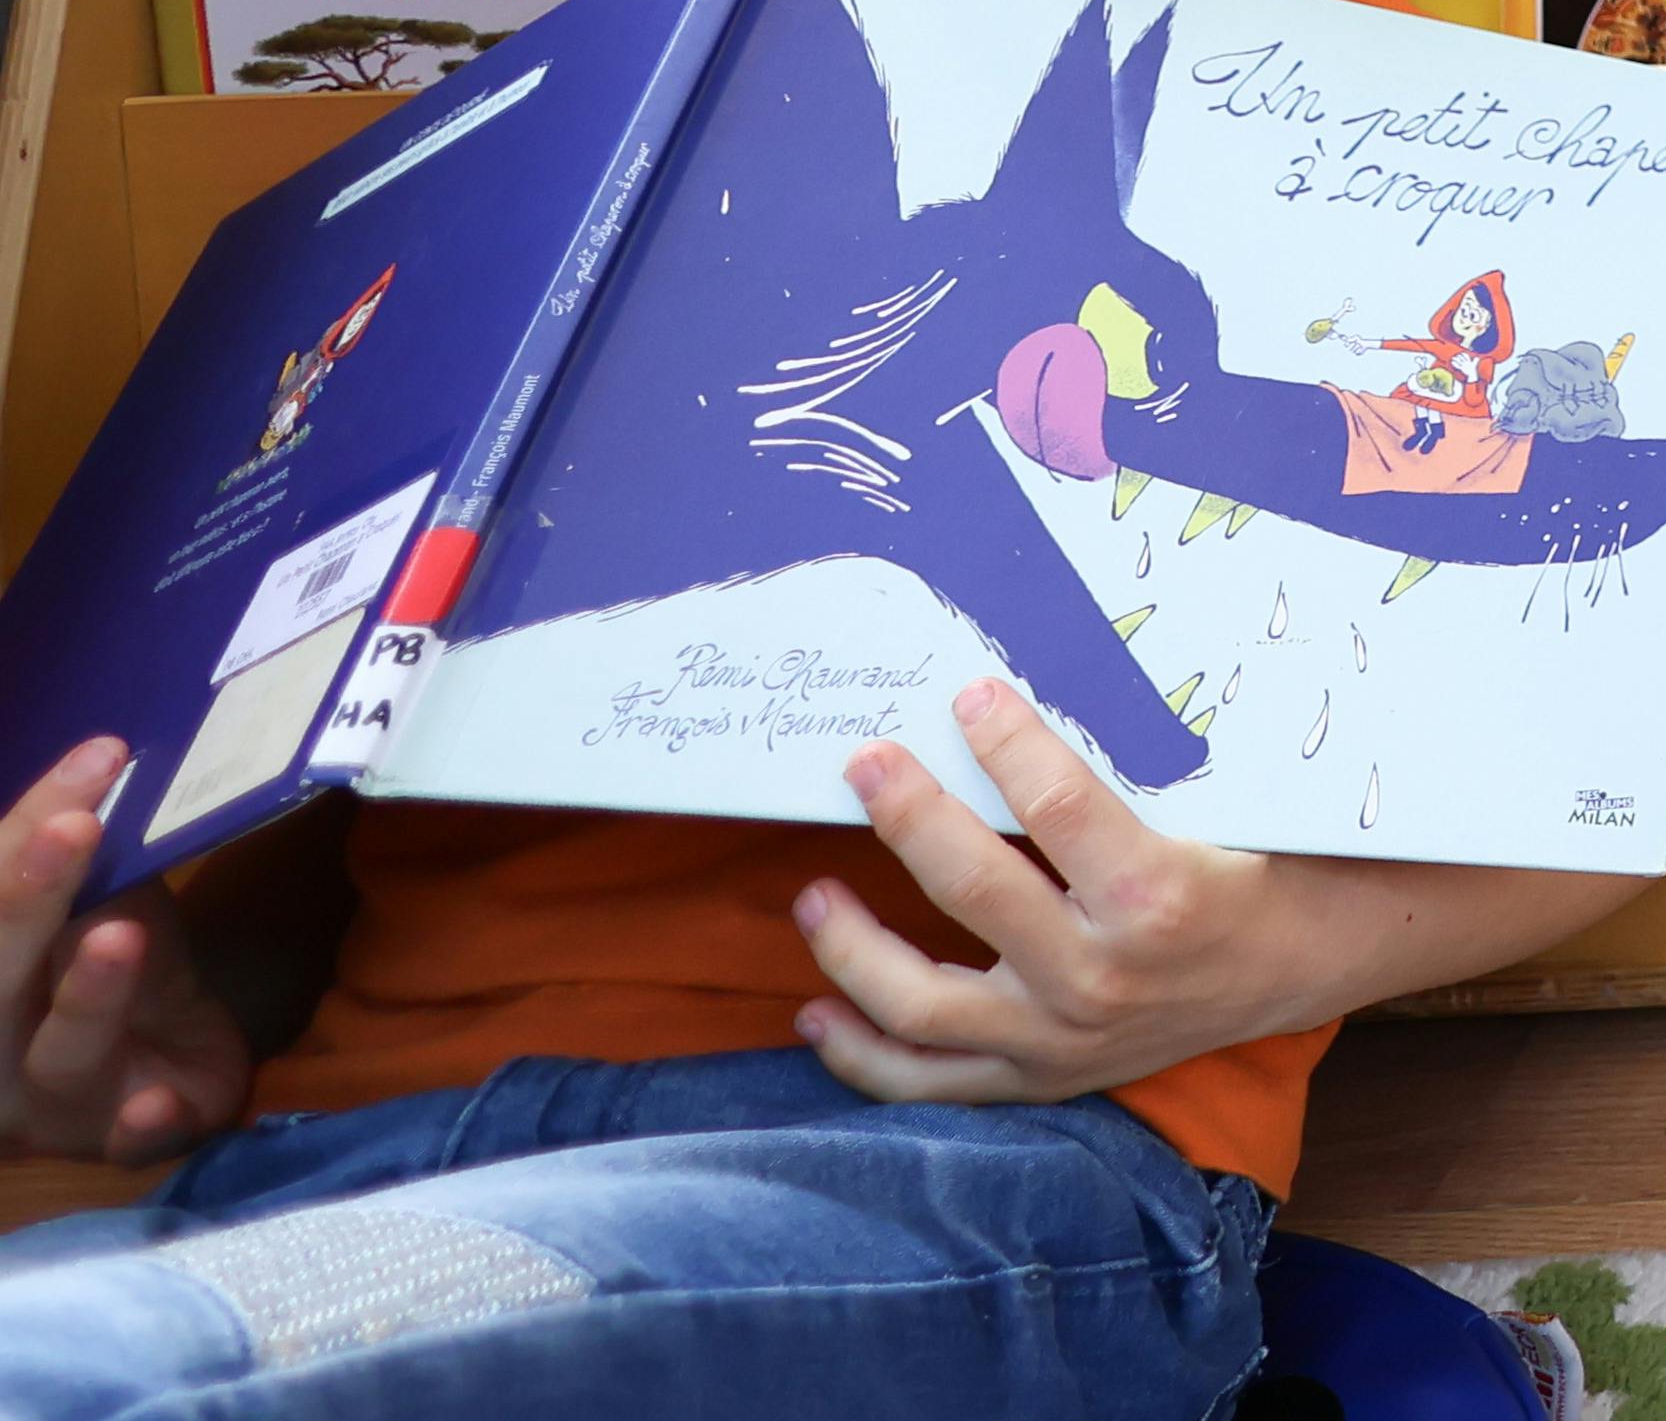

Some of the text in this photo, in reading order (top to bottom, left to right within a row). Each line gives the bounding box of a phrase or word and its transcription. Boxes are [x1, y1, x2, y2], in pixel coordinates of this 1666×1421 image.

[1192, 41, 1324, 123] Un
[1341, 90, 1508, 159] petit
[1275, 137, 1327, 199] à
[471, 434, 511, 487] François
[498, 373, 542, 431] Maumont
[369, 632, 426, 666] PB
[652, 642, 758, 705] Rémi
[740, 696, 903, 753] Maumont
[1567, 808, 1636, 827] MILAN
